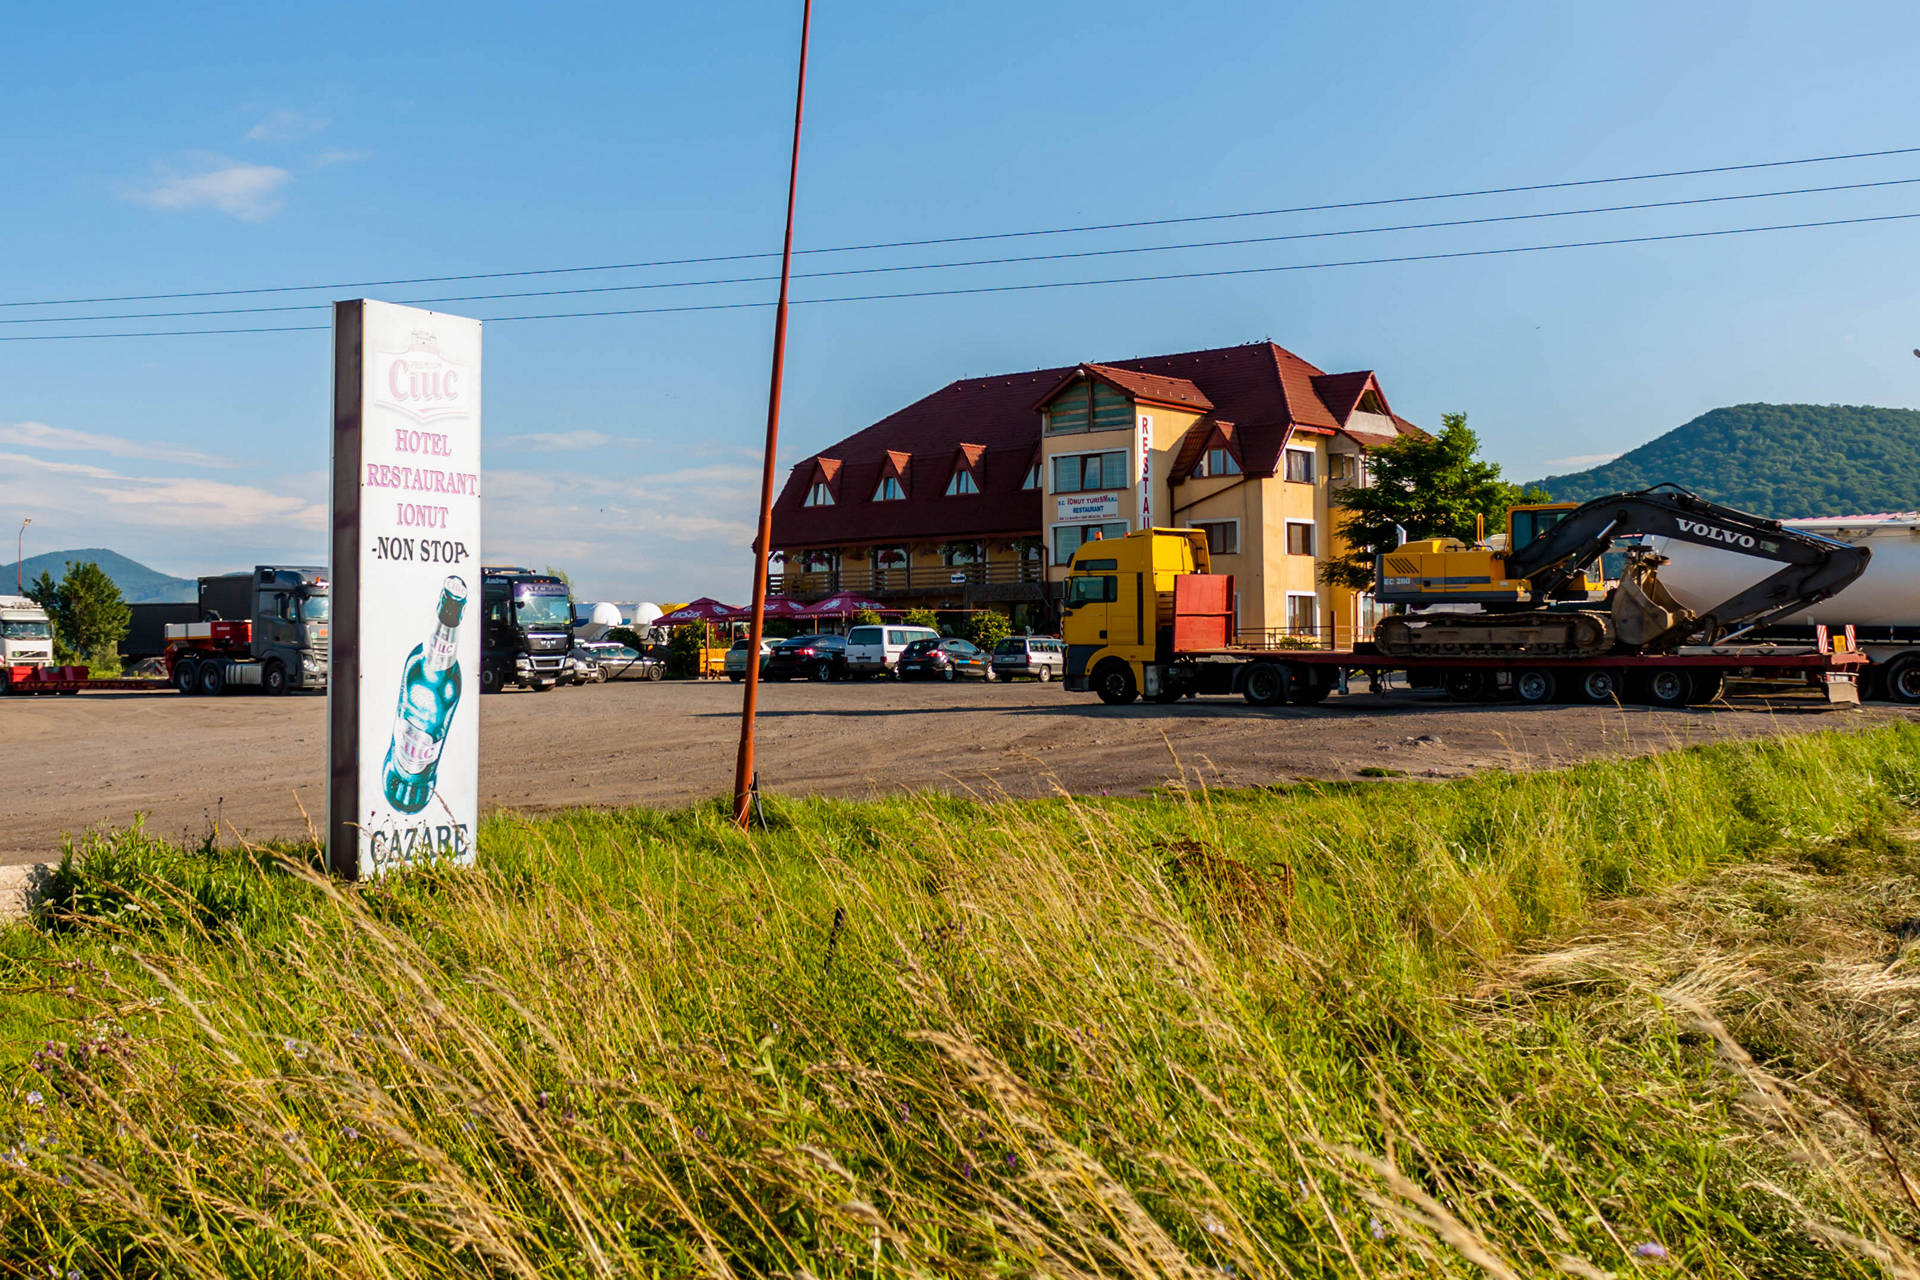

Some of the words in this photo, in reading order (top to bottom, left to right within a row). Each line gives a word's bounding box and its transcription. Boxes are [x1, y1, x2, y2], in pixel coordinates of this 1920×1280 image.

[388, 359, 458, 401] Ciuc
[395, 429, 452, 456] HOTEL
[366, 463, 478, 496] RESTAURANT
[396, 503, 449, 529] IONUT
[1073, 506, 1104, 514] RESTAURANT
[1675, 517, 1755, 548] VOLVO
[370, 823, 469, 865] CAZARE
